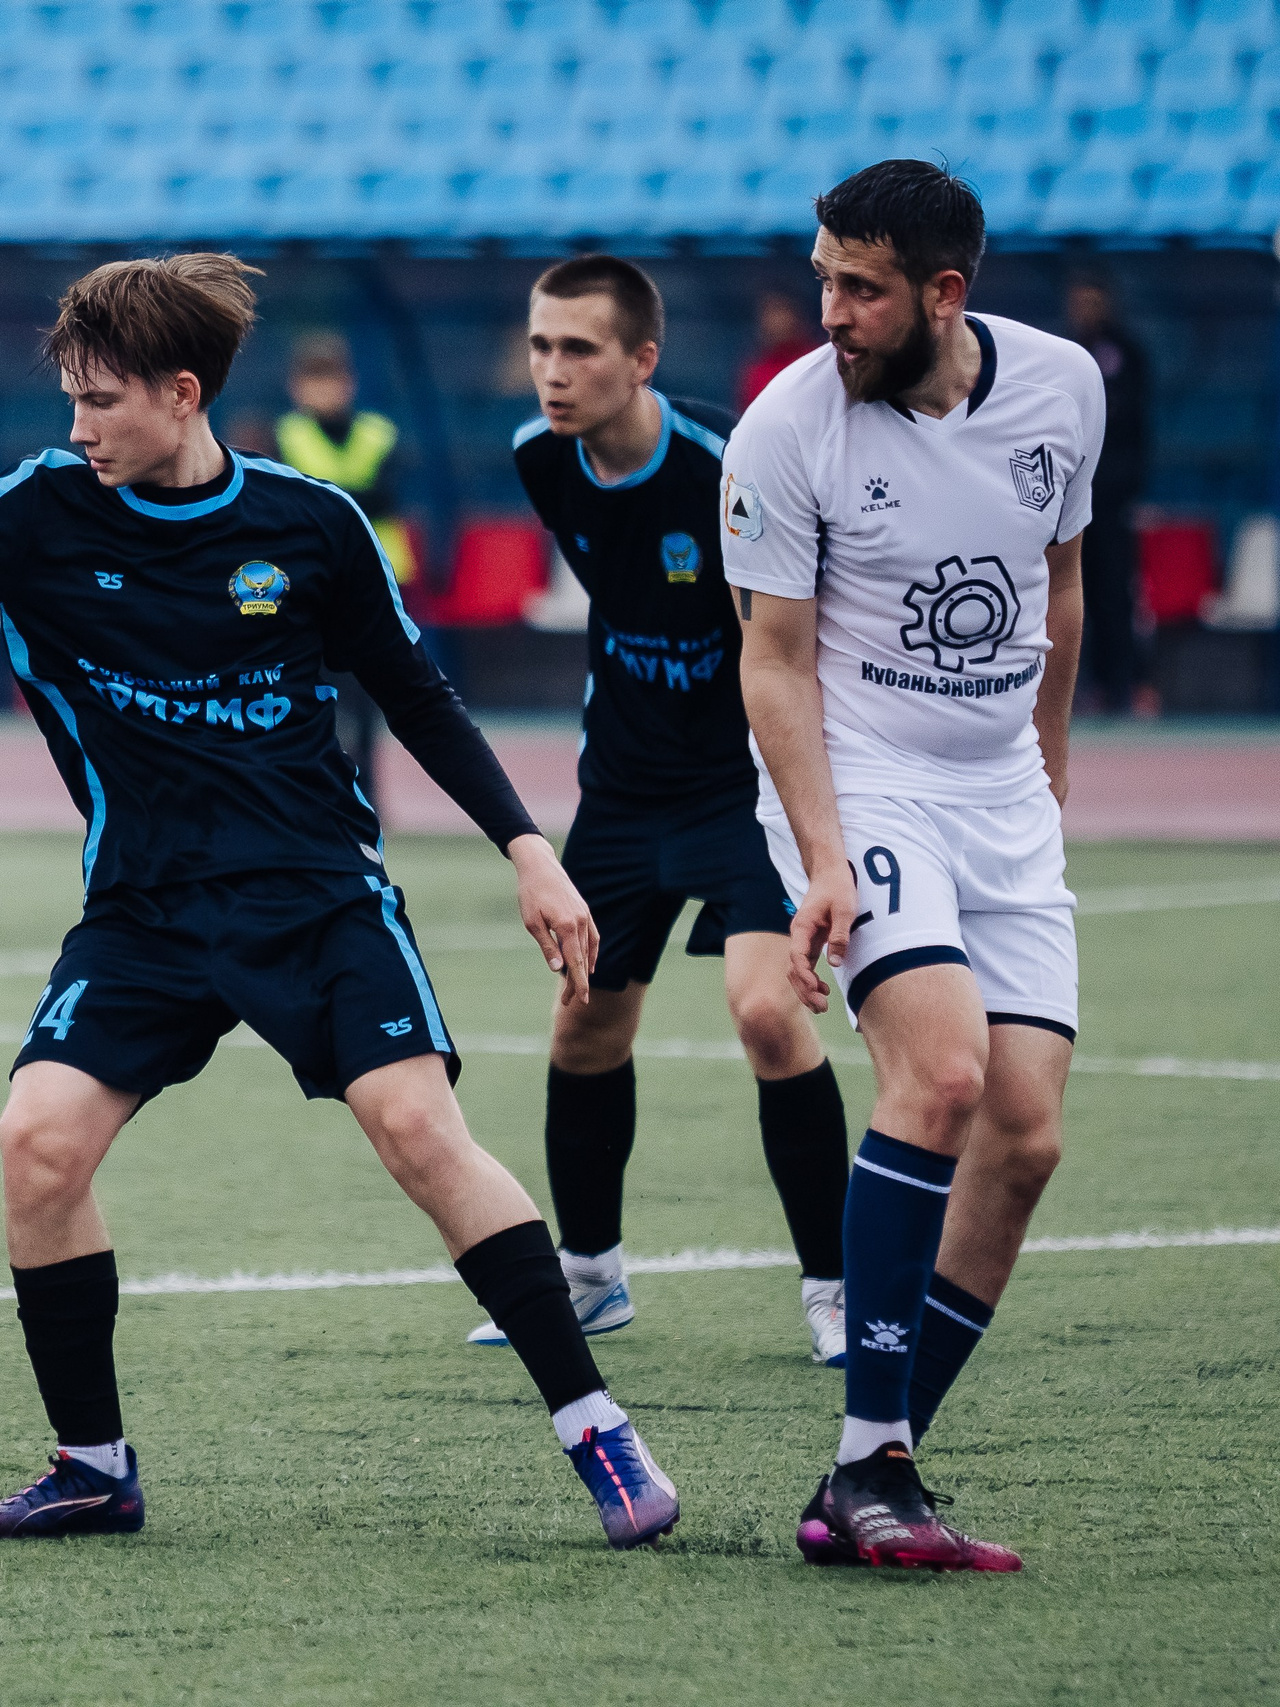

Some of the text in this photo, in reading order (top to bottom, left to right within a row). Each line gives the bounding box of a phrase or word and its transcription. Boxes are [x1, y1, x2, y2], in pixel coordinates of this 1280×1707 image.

[860, 499, 902, 513] KELME
[242, 603, 276, 611] ТРИУМФ
[860, 1337, 909, 1353] KELME
